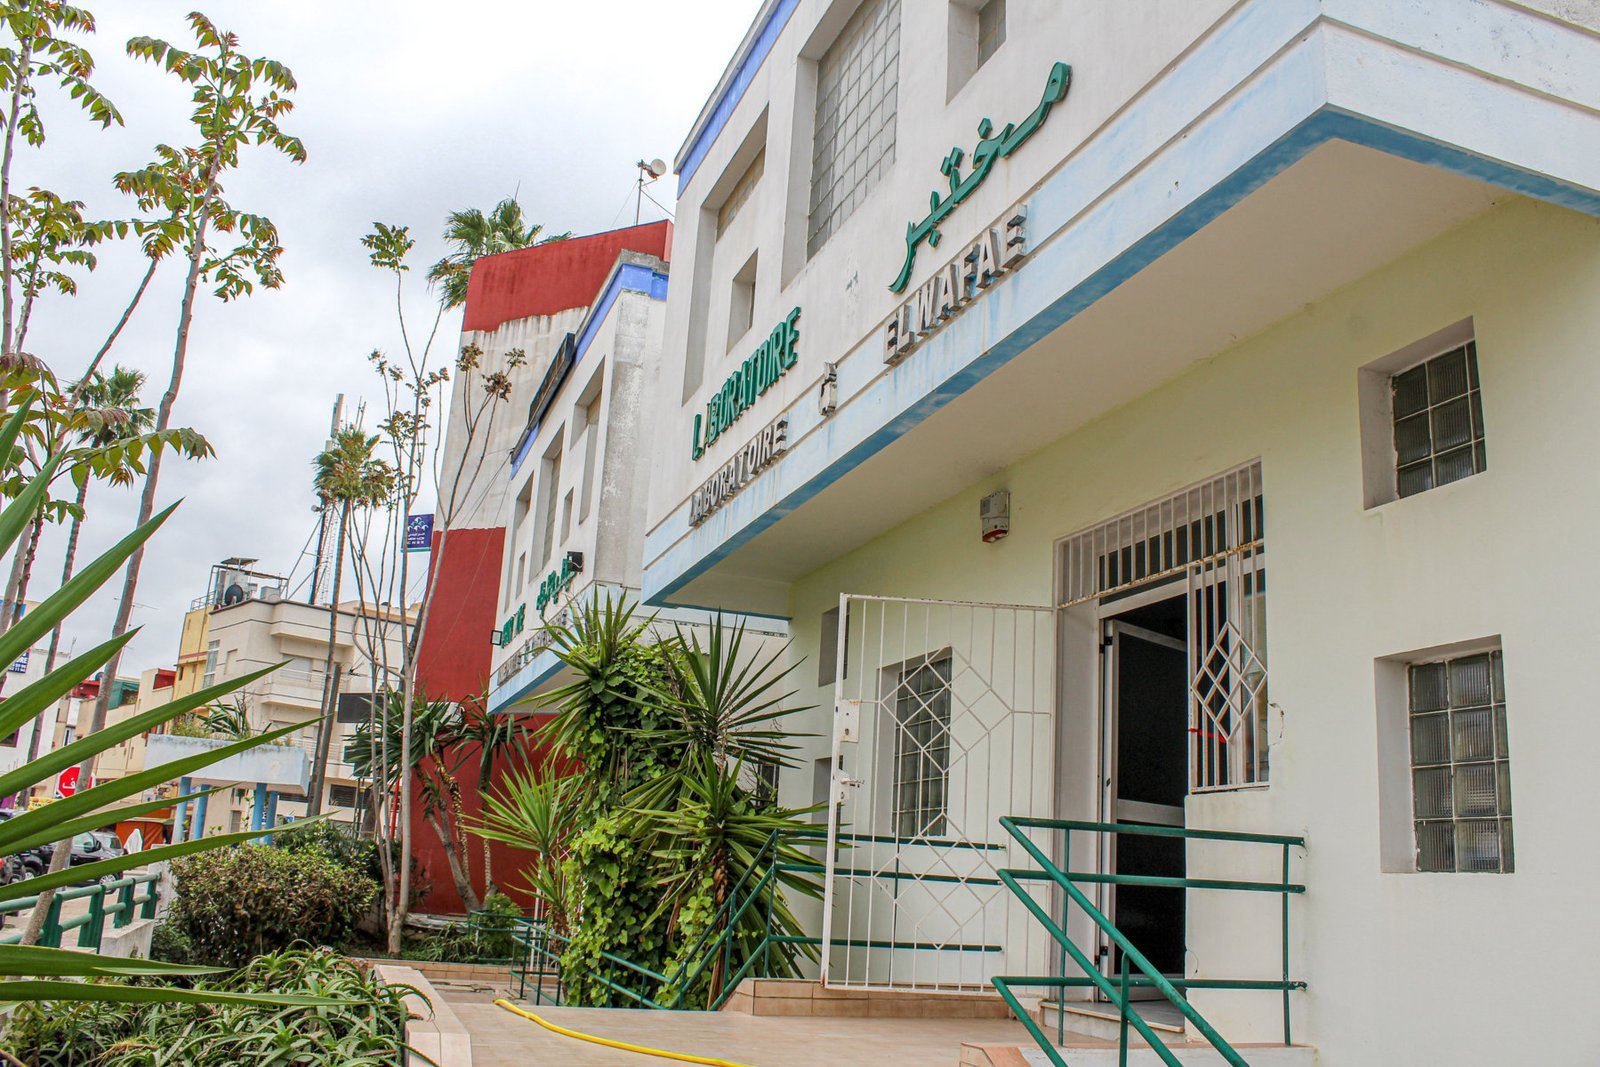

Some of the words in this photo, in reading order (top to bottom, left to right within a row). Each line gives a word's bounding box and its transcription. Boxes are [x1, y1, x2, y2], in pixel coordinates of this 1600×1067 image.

[888, 61, 1073, 293] مختبر
[883, 304, 915, 365] EL
[916, 204, 1028, 337] WAFAE
[691, 306, 802, 462] LBORATOIRE
